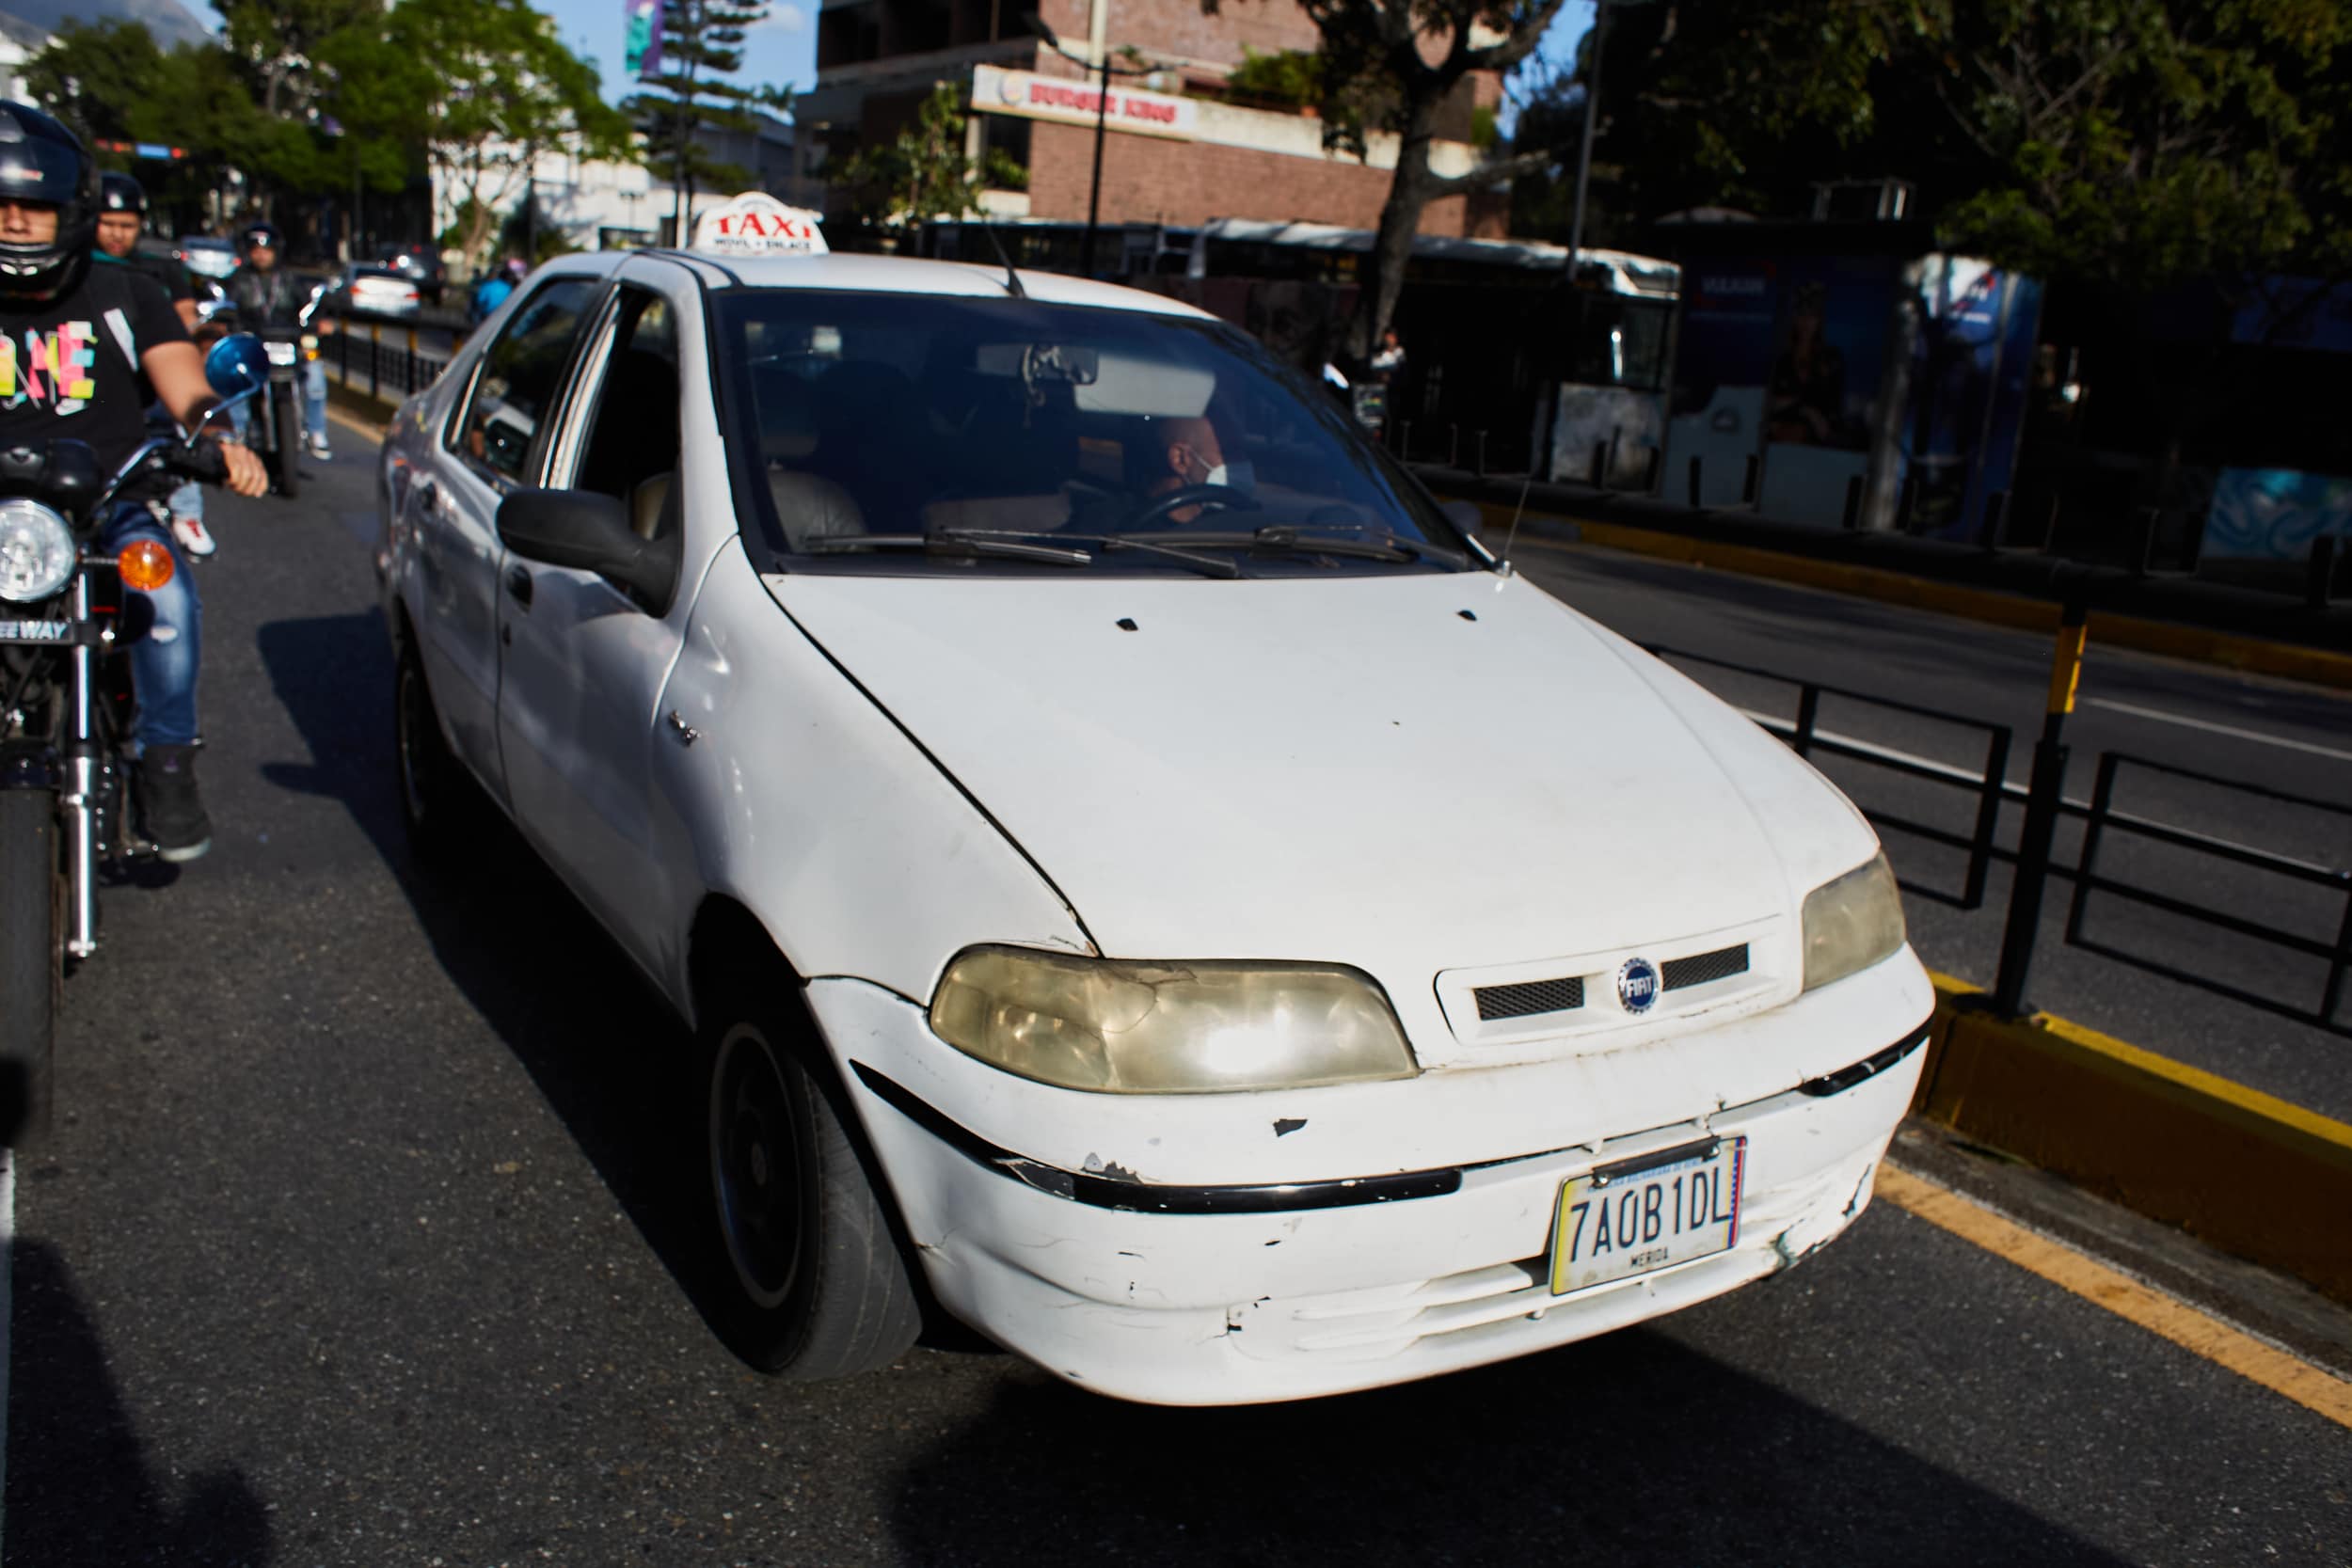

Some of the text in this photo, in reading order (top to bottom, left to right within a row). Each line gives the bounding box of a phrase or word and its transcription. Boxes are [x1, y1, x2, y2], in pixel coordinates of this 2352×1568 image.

[1030, 83, 1117, 114] BURGER
[712, 213, 812, 239] TAXI
[1626, 976, 1653, 998] FIAT
[1629, 1246, 1670, 1269] MERIDA
